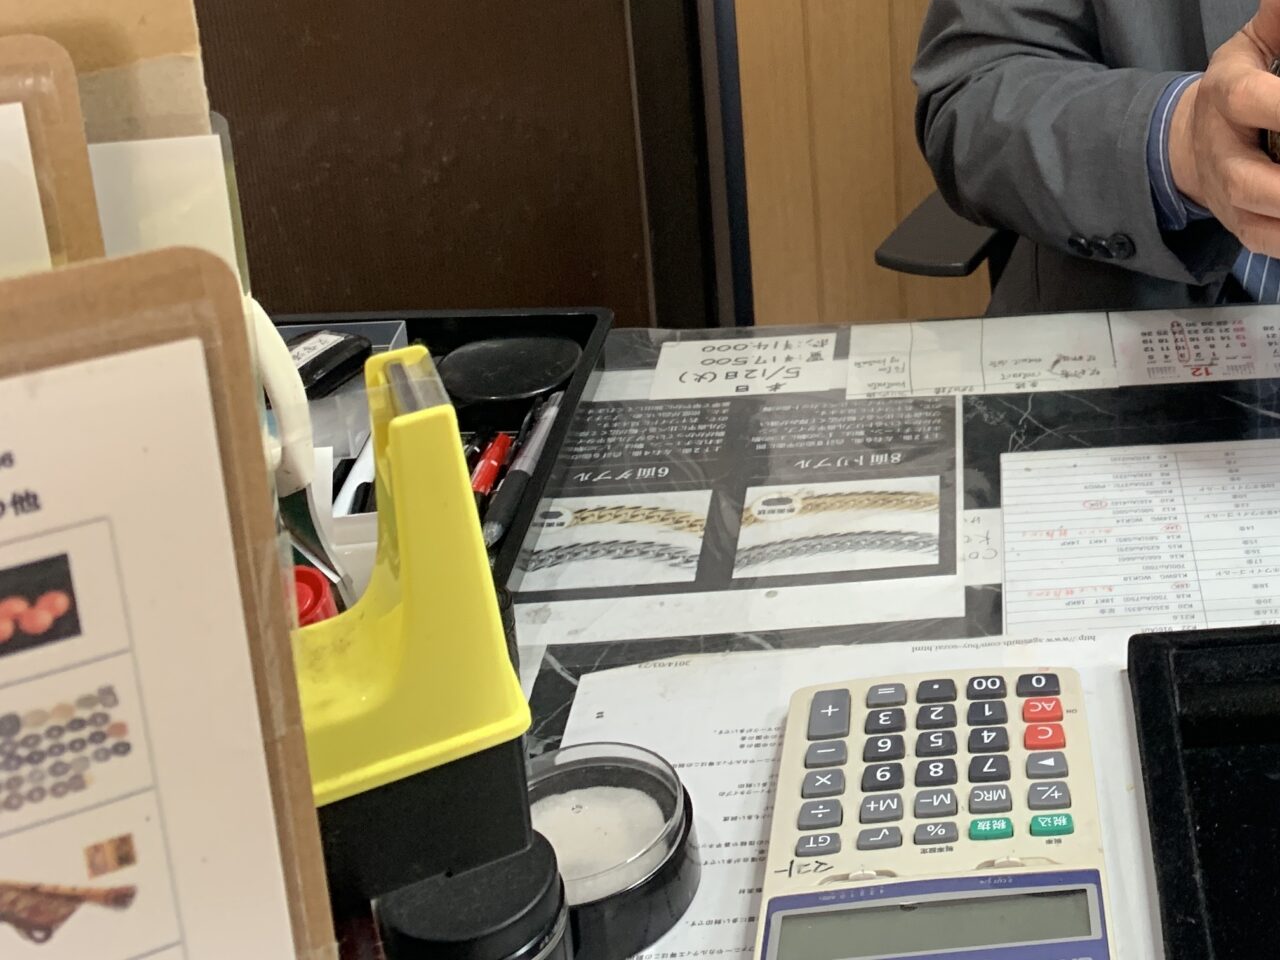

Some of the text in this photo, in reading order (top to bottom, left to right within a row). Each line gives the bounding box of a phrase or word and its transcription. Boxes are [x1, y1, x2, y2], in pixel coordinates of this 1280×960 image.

[1191, 367, 1213, 376] 12
[794, 453, 902, 469] 8面トリプル
[572, 466, 669, 482] 6面ダブル
[973, 676, 1046, 689] 00 0
[879, 711, 892, 724] 3
[930, 707, 943, 720] 2
[984, 704, 992, 716] 1
[1029, 701, 1055, 712] AC
[878, 726, 1052, 752] 6 5 4 C
[876, 767, 890, 780] 9
[929, 763, 943, 777] 8
[982, 758, 996, 772] 7
[866, 799, 897, 812] M+
[974, 789, 1006, 802] MRC
[977, 816, 1067, 831] 税抜 税込
[806, 825, 945, 847] GT %
